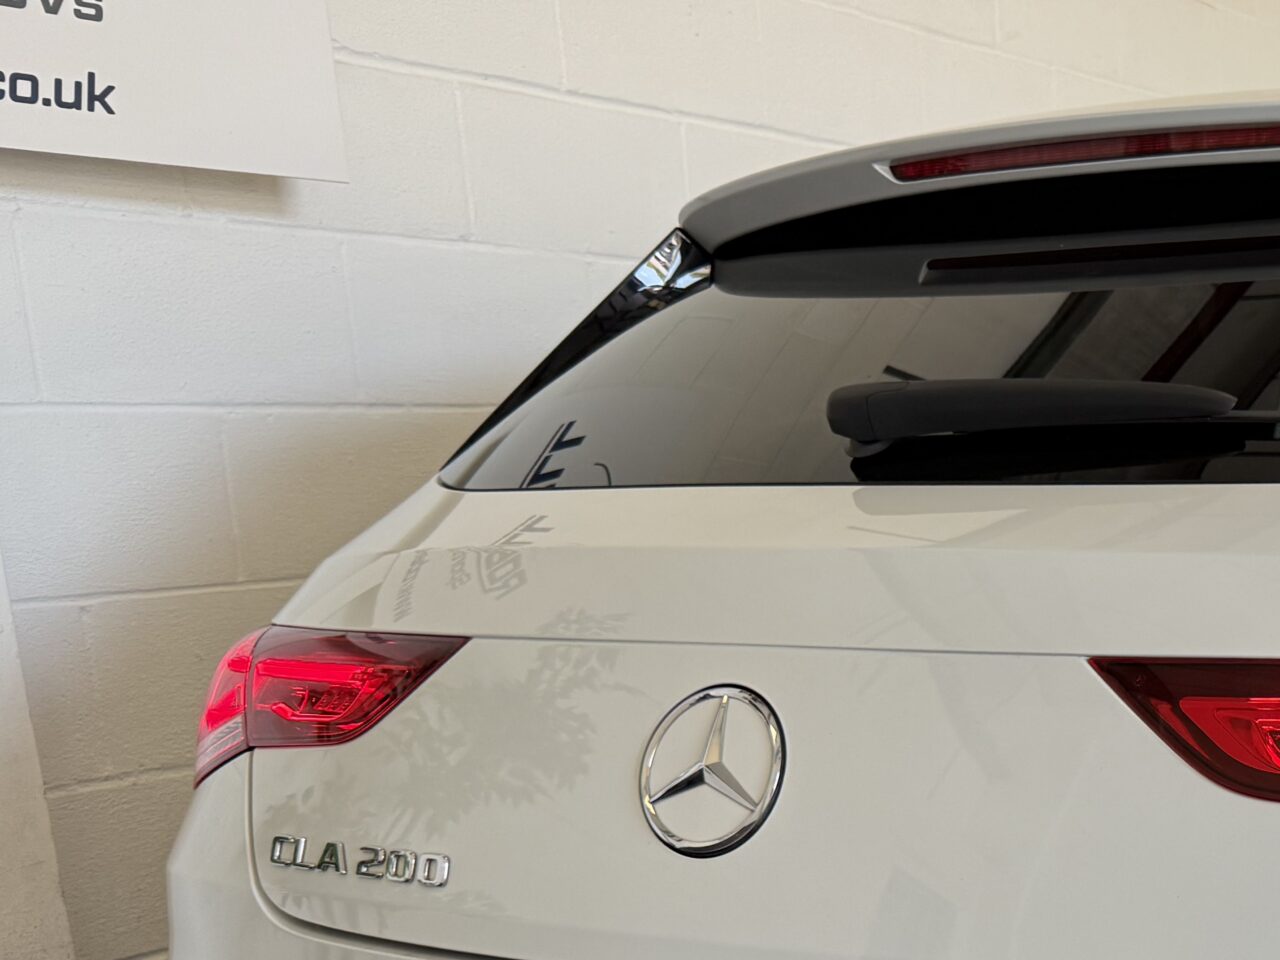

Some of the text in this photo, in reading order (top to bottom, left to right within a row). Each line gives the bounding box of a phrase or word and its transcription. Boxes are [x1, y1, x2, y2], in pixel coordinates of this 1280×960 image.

[0, 70, 116, 115] o.uk
[270, 835, 450, 887] CLA 200
